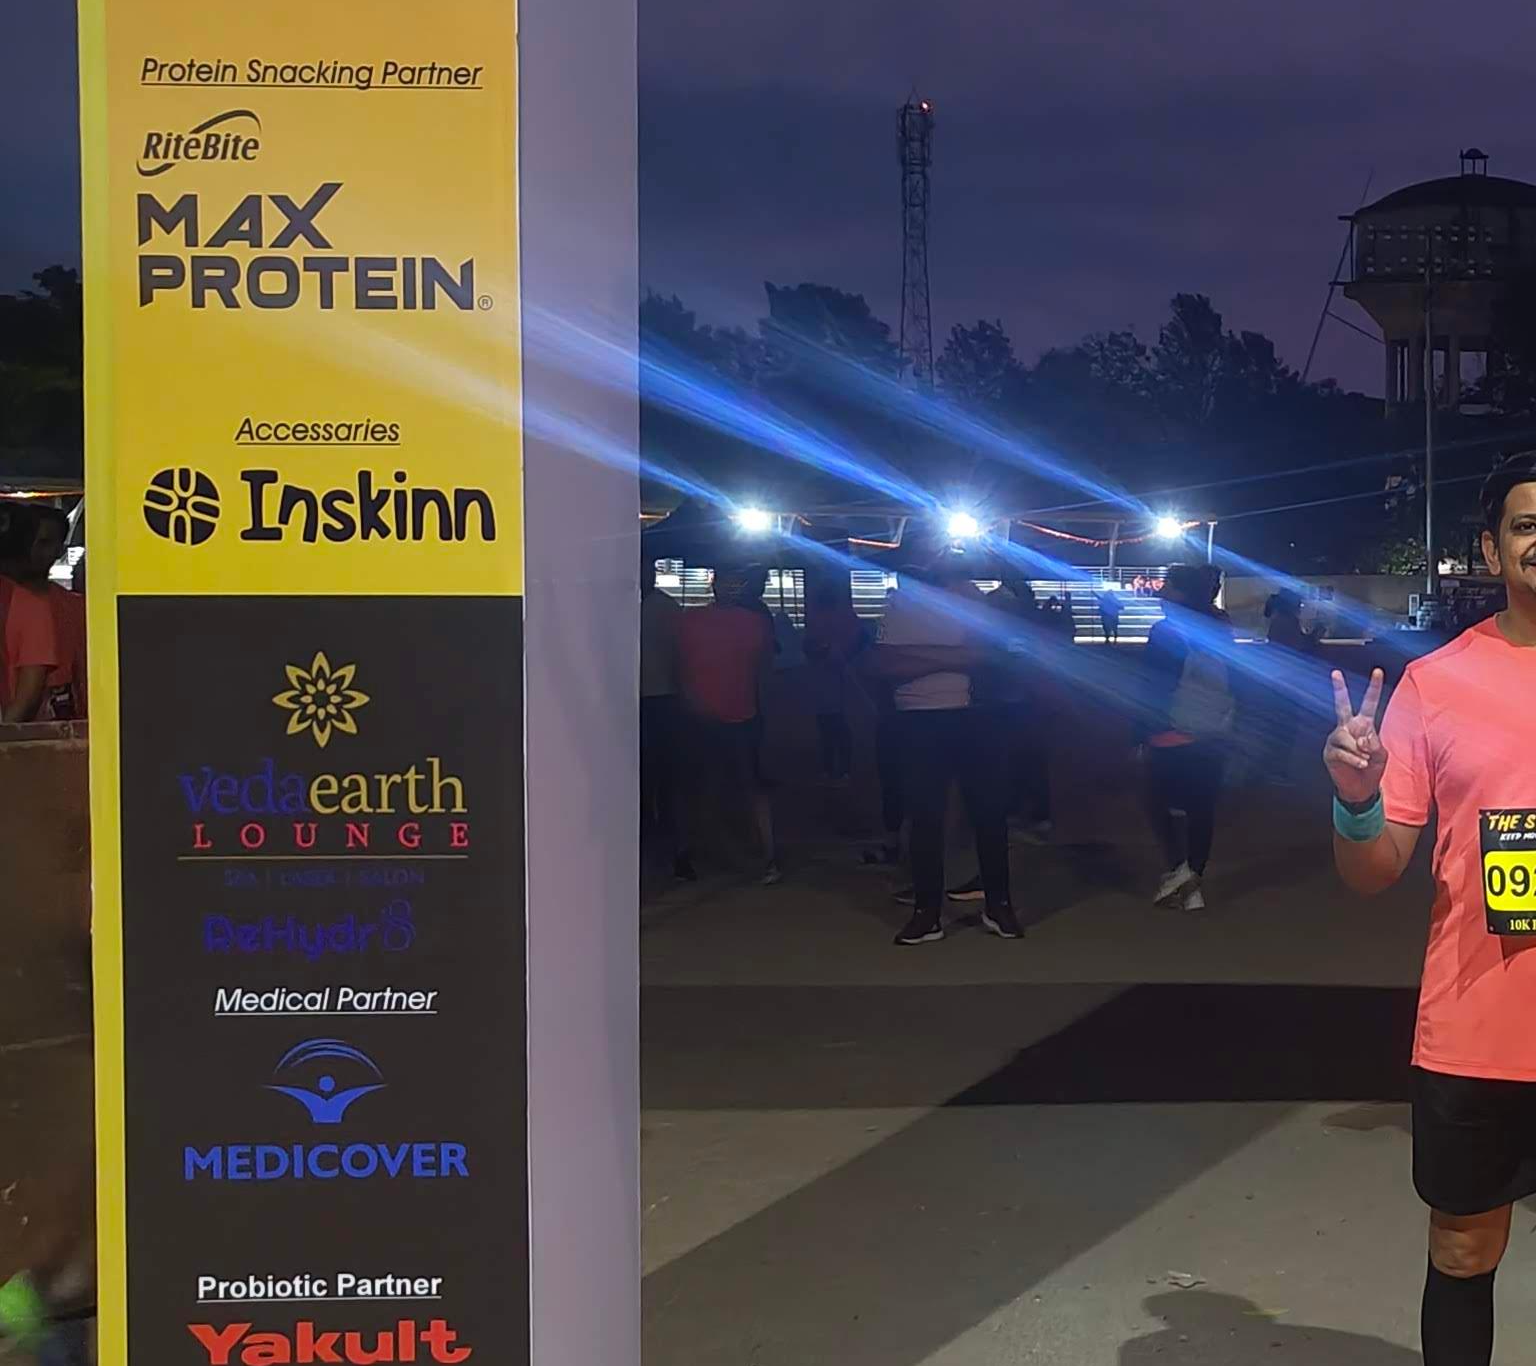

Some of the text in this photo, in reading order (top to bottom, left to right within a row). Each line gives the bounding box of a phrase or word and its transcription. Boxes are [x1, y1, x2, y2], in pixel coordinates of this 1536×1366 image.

[142, 58, 483, 90] Protein Snacking Partner
[143, 131, 260, 161] RiteBite
[137, 182, 344, 249] MAX
[234, 418, 400, 442] Accessaries
[240, 469, 497, 544] Inskinn
[193, 823, 469, 848] LOUNGE
[1488, 815, 1521, 832] THE
[1510, 919, 1531, 930] 10K
[214, 987, 437, 1011] Medical Partner
[184, 1143, 469, 1180] MEDICOVER
[198, 1273, 442, 1299] Probiotic Partner
